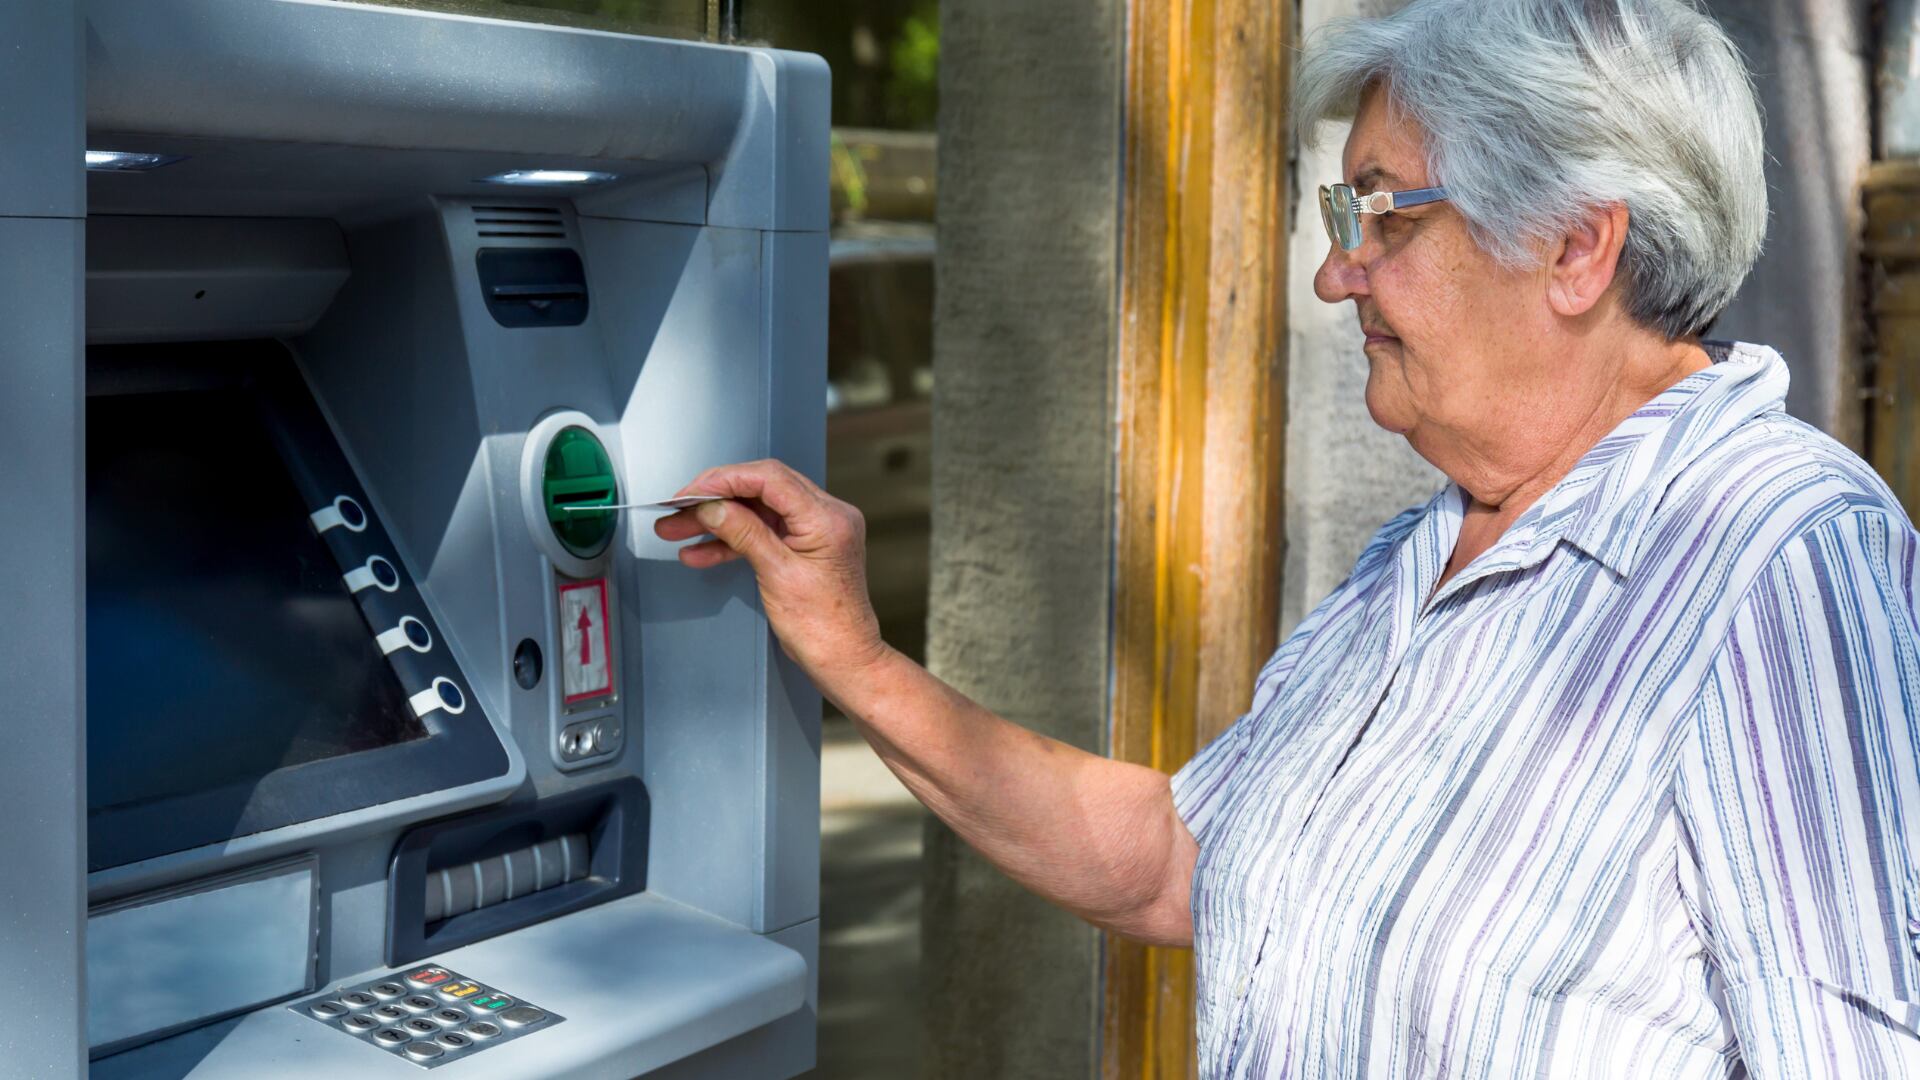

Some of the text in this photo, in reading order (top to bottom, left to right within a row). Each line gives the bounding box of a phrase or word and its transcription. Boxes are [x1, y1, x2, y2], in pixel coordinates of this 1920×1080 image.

[378, 985, 398, 993] 3
[411, 998, 429, 1007] 6
[383, 1007, 400, 1016] 5
[441, 1010, 459, 1019] 9
[353, 1017, 371, 1025] 4
[412, 1020, 432, 1029] 8
[383, 1030, 400, 1039] 7
[444, 1034, 463, 1043] 0
